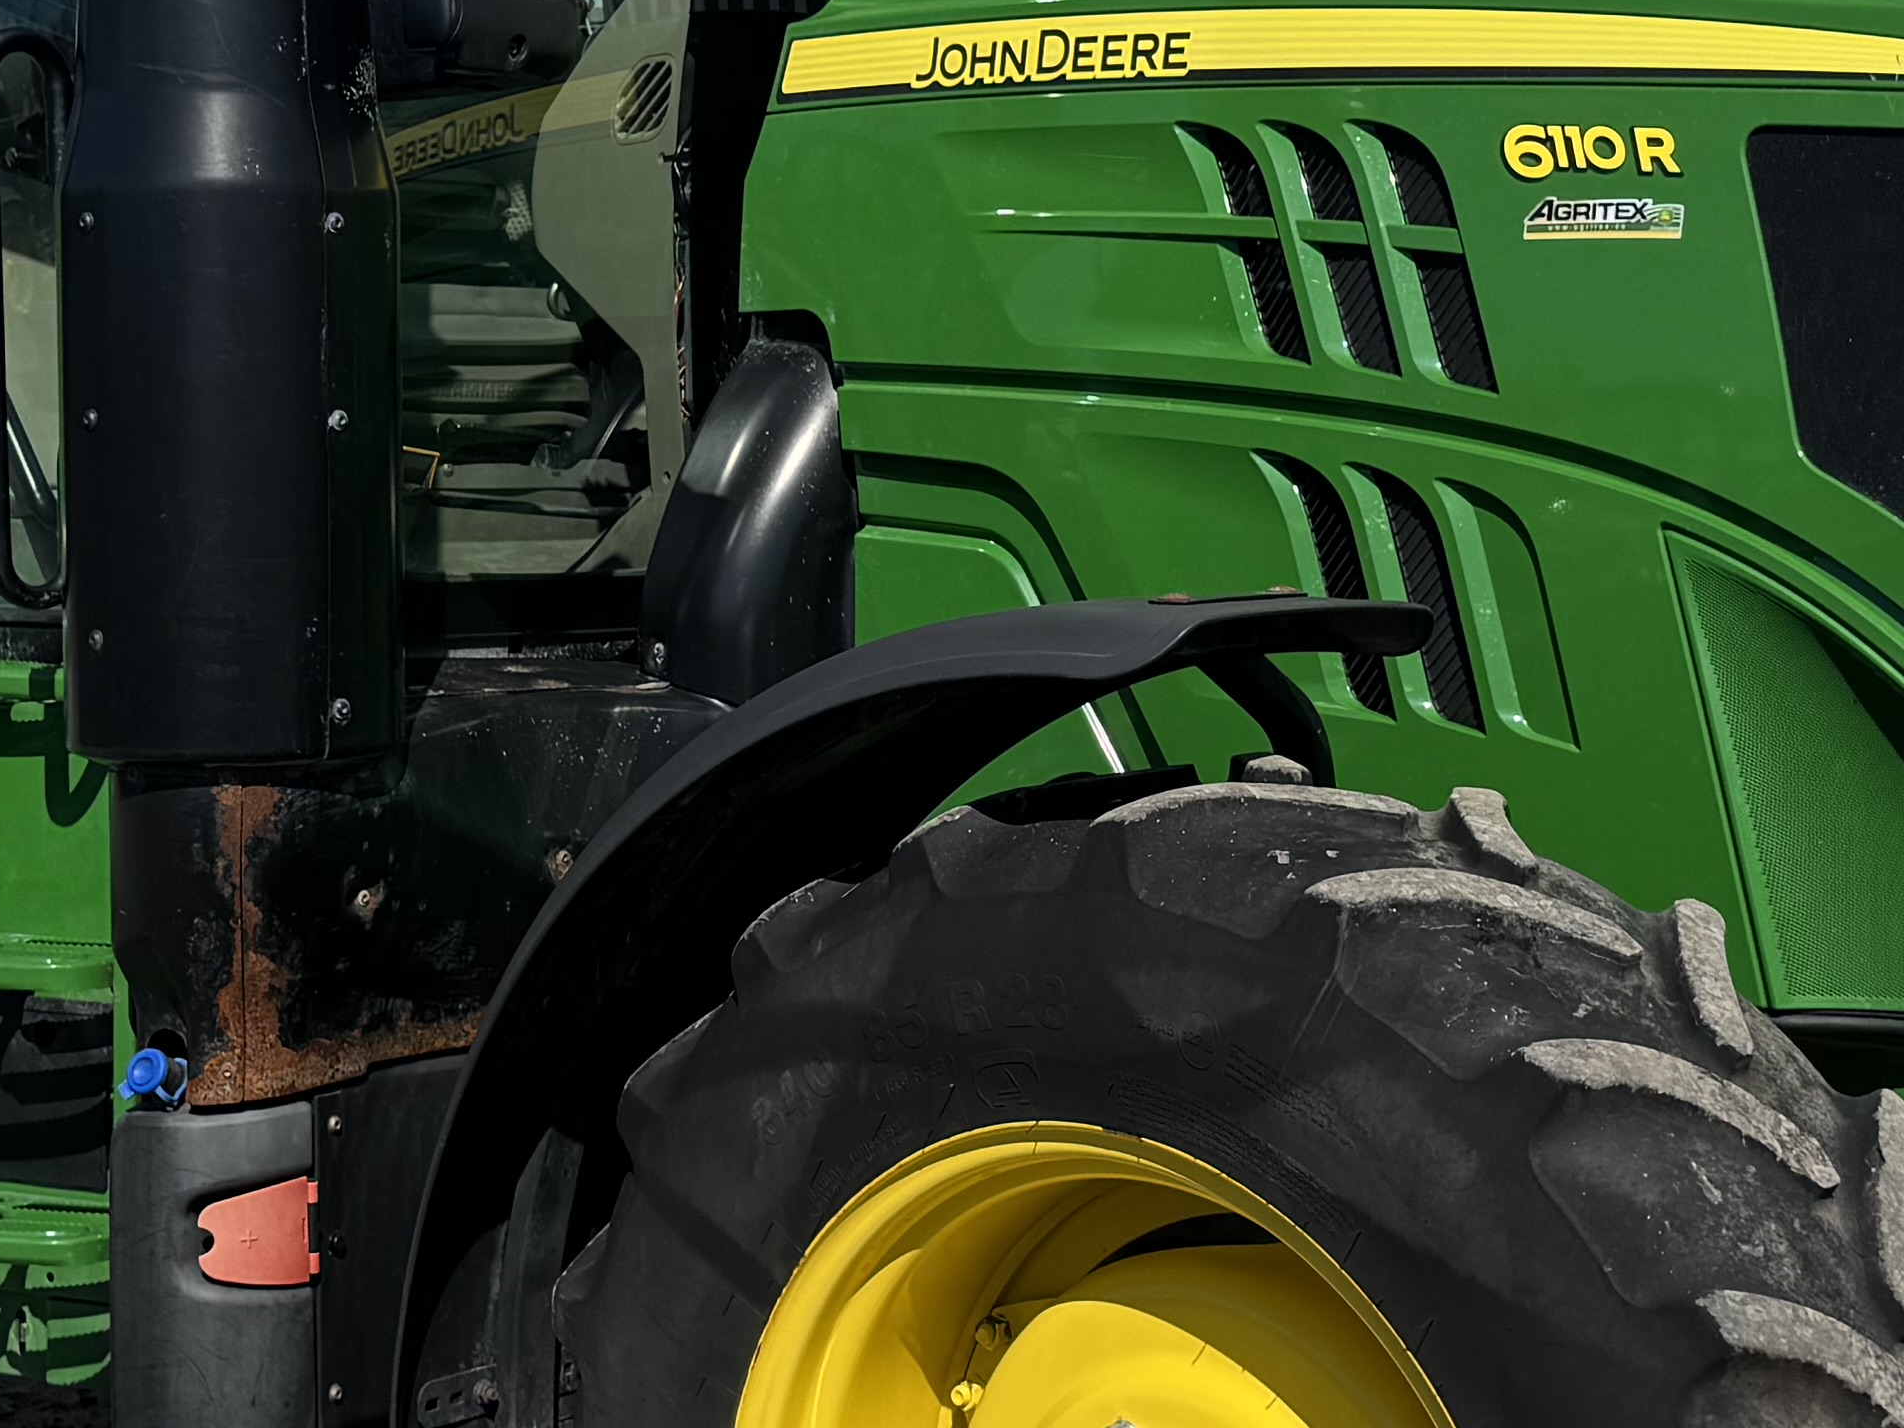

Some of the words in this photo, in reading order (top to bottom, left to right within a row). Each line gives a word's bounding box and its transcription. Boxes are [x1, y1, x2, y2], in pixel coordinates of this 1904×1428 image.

[914, 35, 1029, 83] JOHN
[1035, 28, 1192, 75] DEERE
[1501, 123, 1627, 181] 6110
[1632, 125, 1684, 176] R
[1527, 198, 1651, 222] AGRITEX
[946, 978, 994, 1037] R
